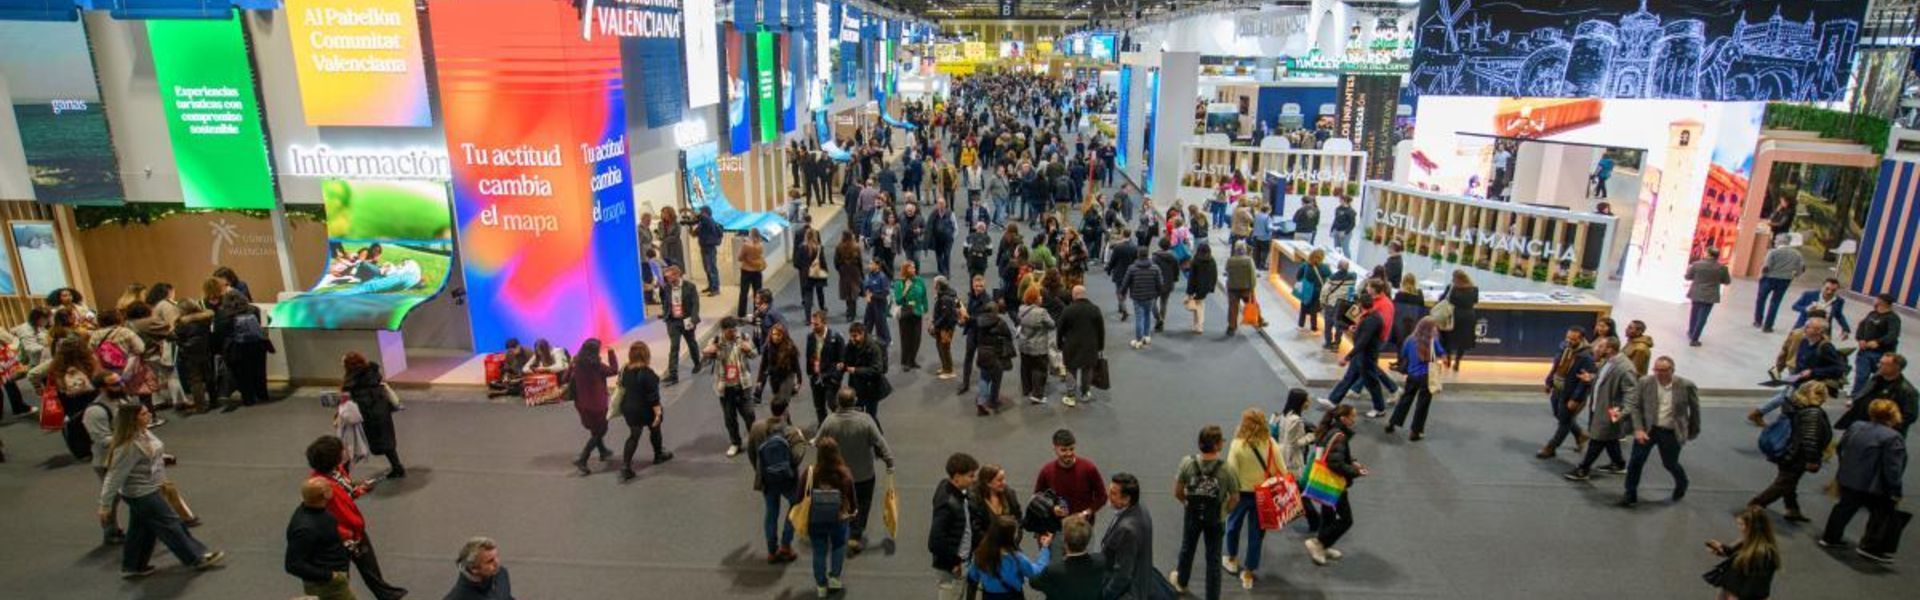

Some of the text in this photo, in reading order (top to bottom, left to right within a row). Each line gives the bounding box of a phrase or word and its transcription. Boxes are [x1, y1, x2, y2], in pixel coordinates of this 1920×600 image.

[303, 7, 400, 27] Al Pabellón
[598, 7, 681, 38] VALENCIANA
[309, 30, 400, 50] Comunitat
[311, 53, 407, 74] Valenciana
[51, 99, 88, 115] ganas
[291, 146, 449, 175] Información
[461, 142, 562, 166] Tu actitud
[581, 134, 625, 165] Tu actitud
[479, 173, 553, 196] cambia
[591, 165, 622, 192] cambia
[481, 204, 559, 238] el mapa
[592, 200, 627, 224] el mapa
[1375, 208, 1437, 239] CASTILLA
[1477, 231, 1577, 263] MANCHA
